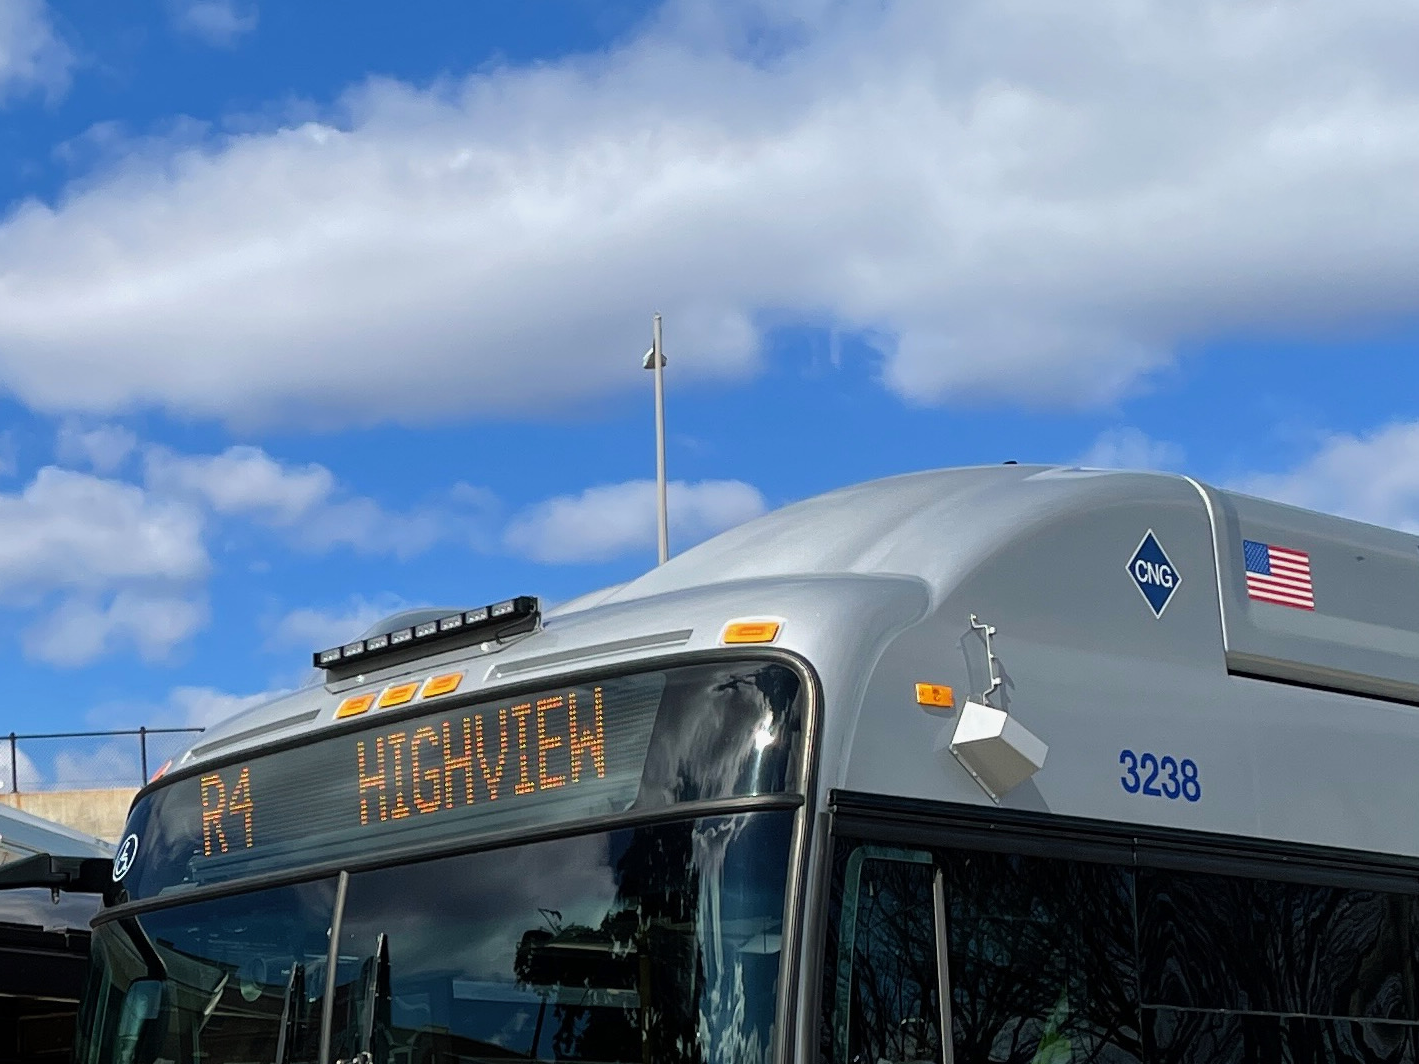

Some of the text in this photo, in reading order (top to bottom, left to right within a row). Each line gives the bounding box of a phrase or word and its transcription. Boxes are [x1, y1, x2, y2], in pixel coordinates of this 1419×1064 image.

[1134, 559, 1173, 588] CNG
[200, 686, 606, 857] R4 HIGHVIEW
[1119, 749, 1201, 802] 3238
